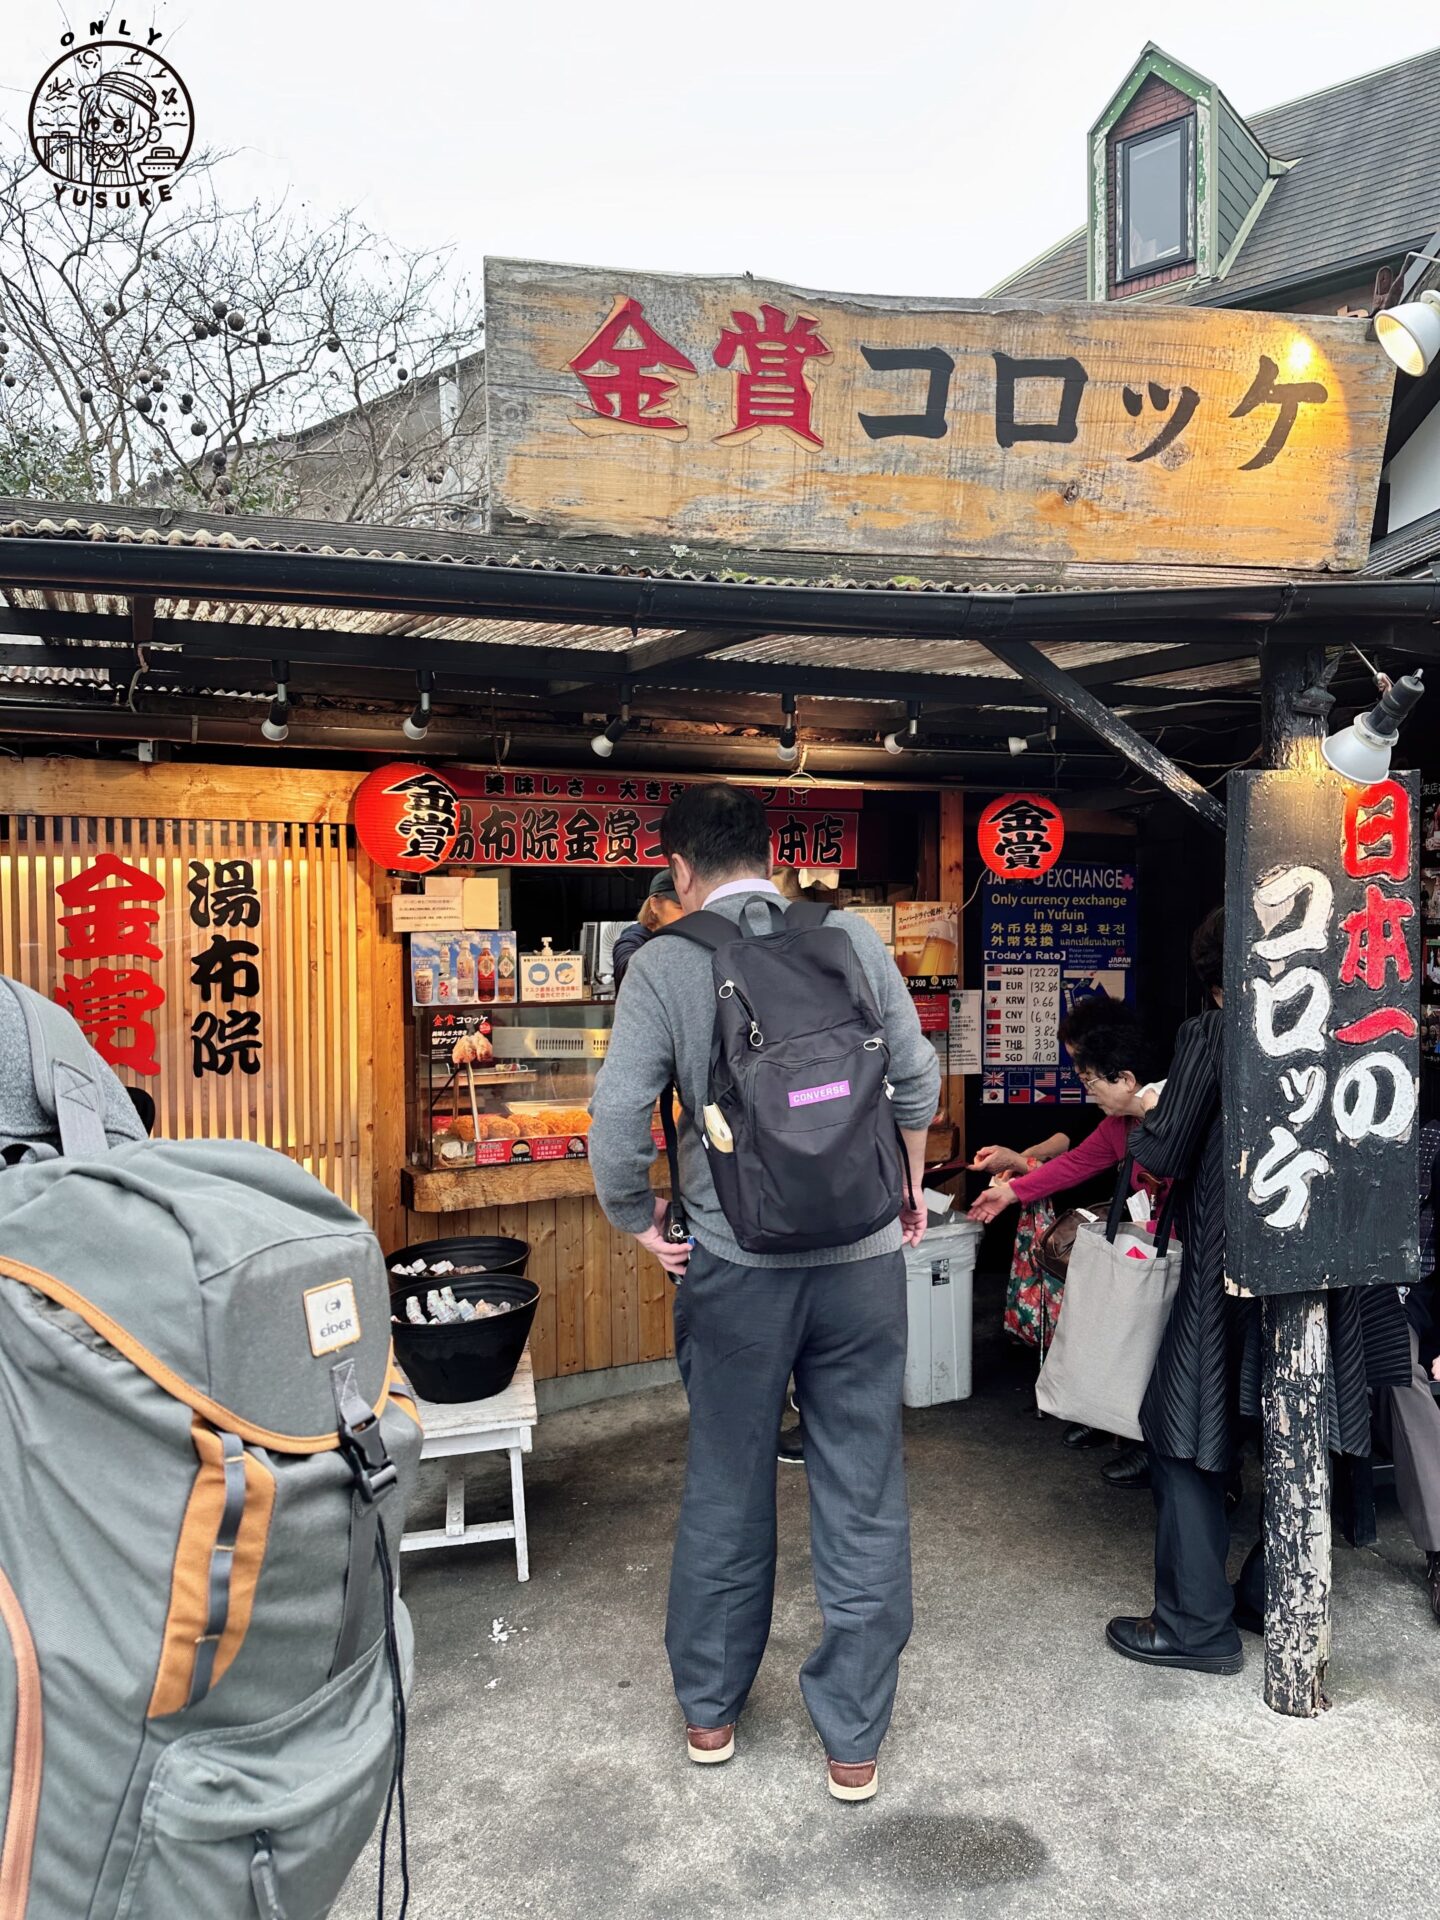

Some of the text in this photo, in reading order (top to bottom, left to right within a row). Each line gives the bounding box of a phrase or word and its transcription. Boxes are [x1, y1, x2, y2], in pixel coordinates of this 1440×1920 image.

[566, 294, 1329, 473] 金賞コロッケ
[382, 772, 459, 863] 金賞
[986, 800, 1056, 870] 金賞
[1047, 868, 1123, 889] EXCHANGE
[991, 893, 1127, 908] Only currency exchange
[1034, 909, 1085, 920] in Yufuin
[54, 853, 166, 1076] 金賞
[1333, 778, 1417, 1141] 日本一の
[187, 859, 263, 1078] 湯布院
[1006, 967, 1024, 975] USD
[1006, 982, 1023, 990] EUR
[1005, 996, 1026, 1004] KRW
[433, 1013, 488, 1026] 金賞コロッケ
[1005, 1011, 1024, 1019] CNY
[1005, 1025, 1025, 1033] TWD
[1005, 1040, 1023, 1049] THB
[1250, 864, 1334, 1231] コロッケ
[1005, 1053, 1023, 1062] SGD
[793, 1084, 845, 1103] CONVERSE
